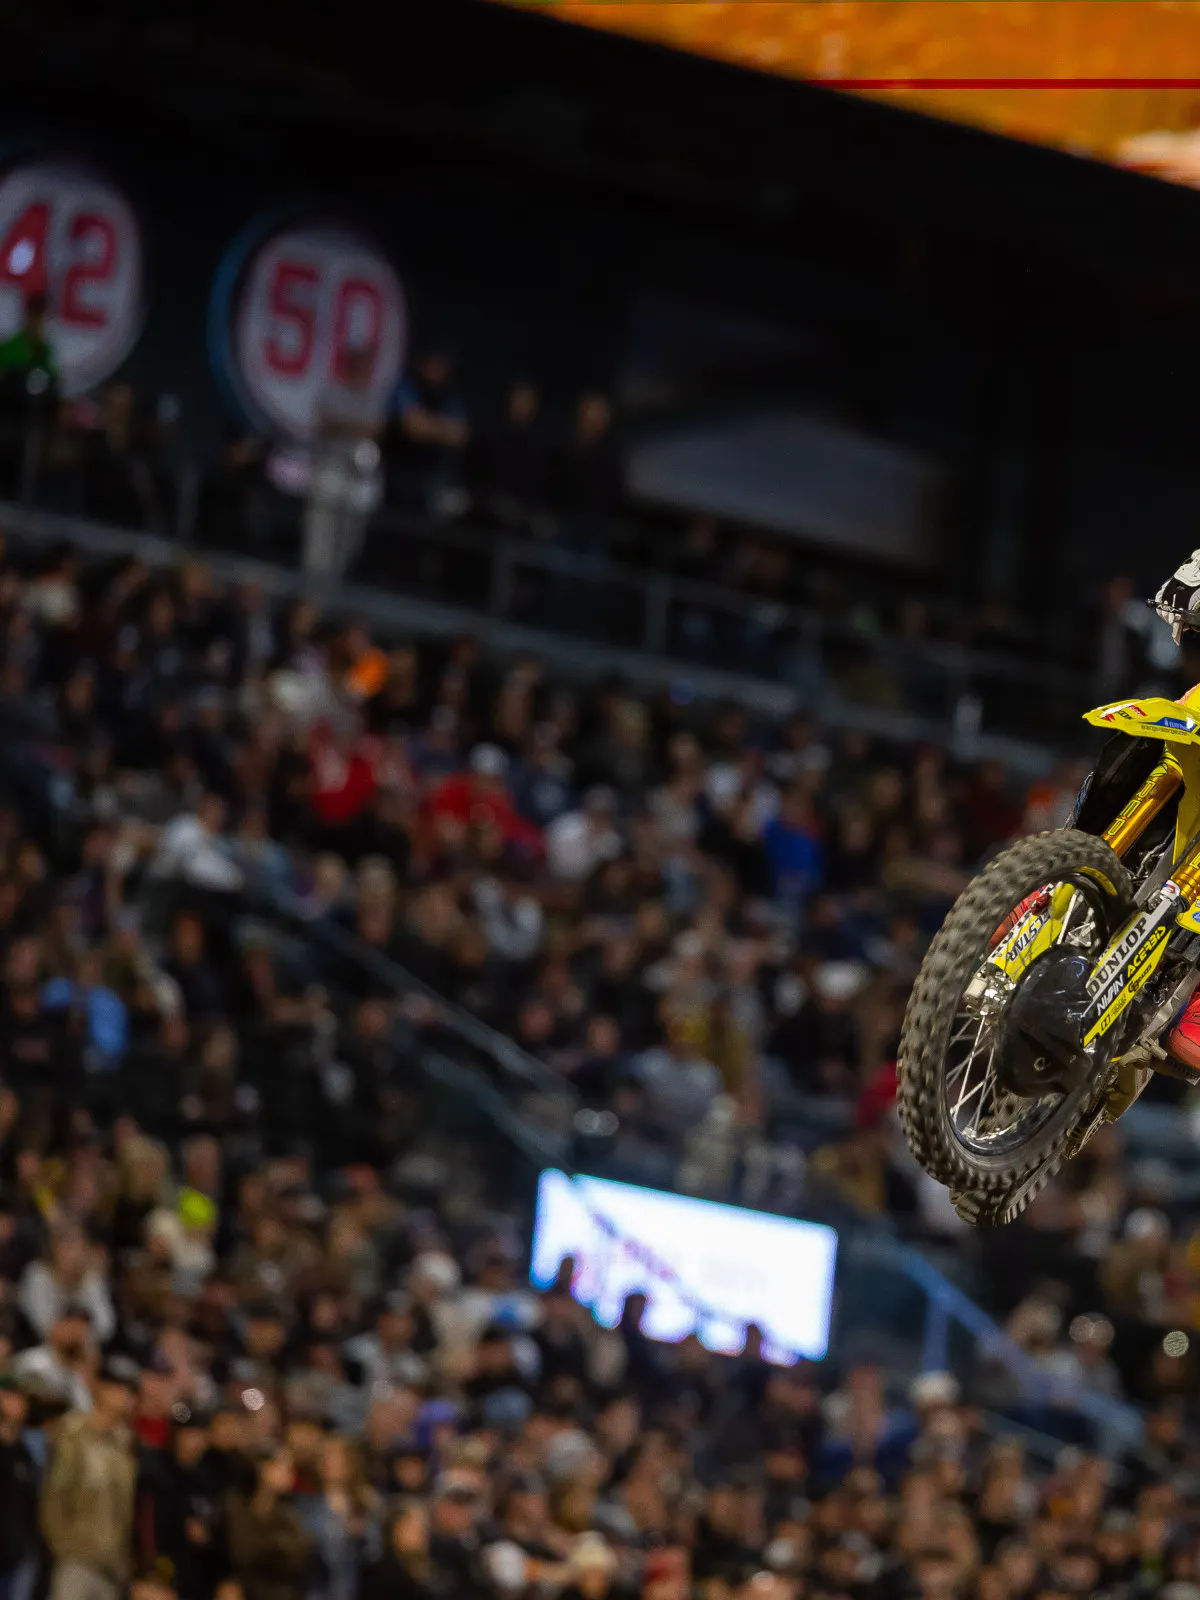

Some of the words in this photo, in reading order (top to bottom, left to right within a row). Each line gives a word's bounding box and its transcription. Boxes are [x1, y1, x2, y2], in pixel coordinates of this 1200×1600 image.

[0, 202, 118, 330] 42
[264, 258, 385, 388] 50
[1086, 917, 1147, 999] DUNLOP
[1127, 925, 1167, 978] ACERBIS
